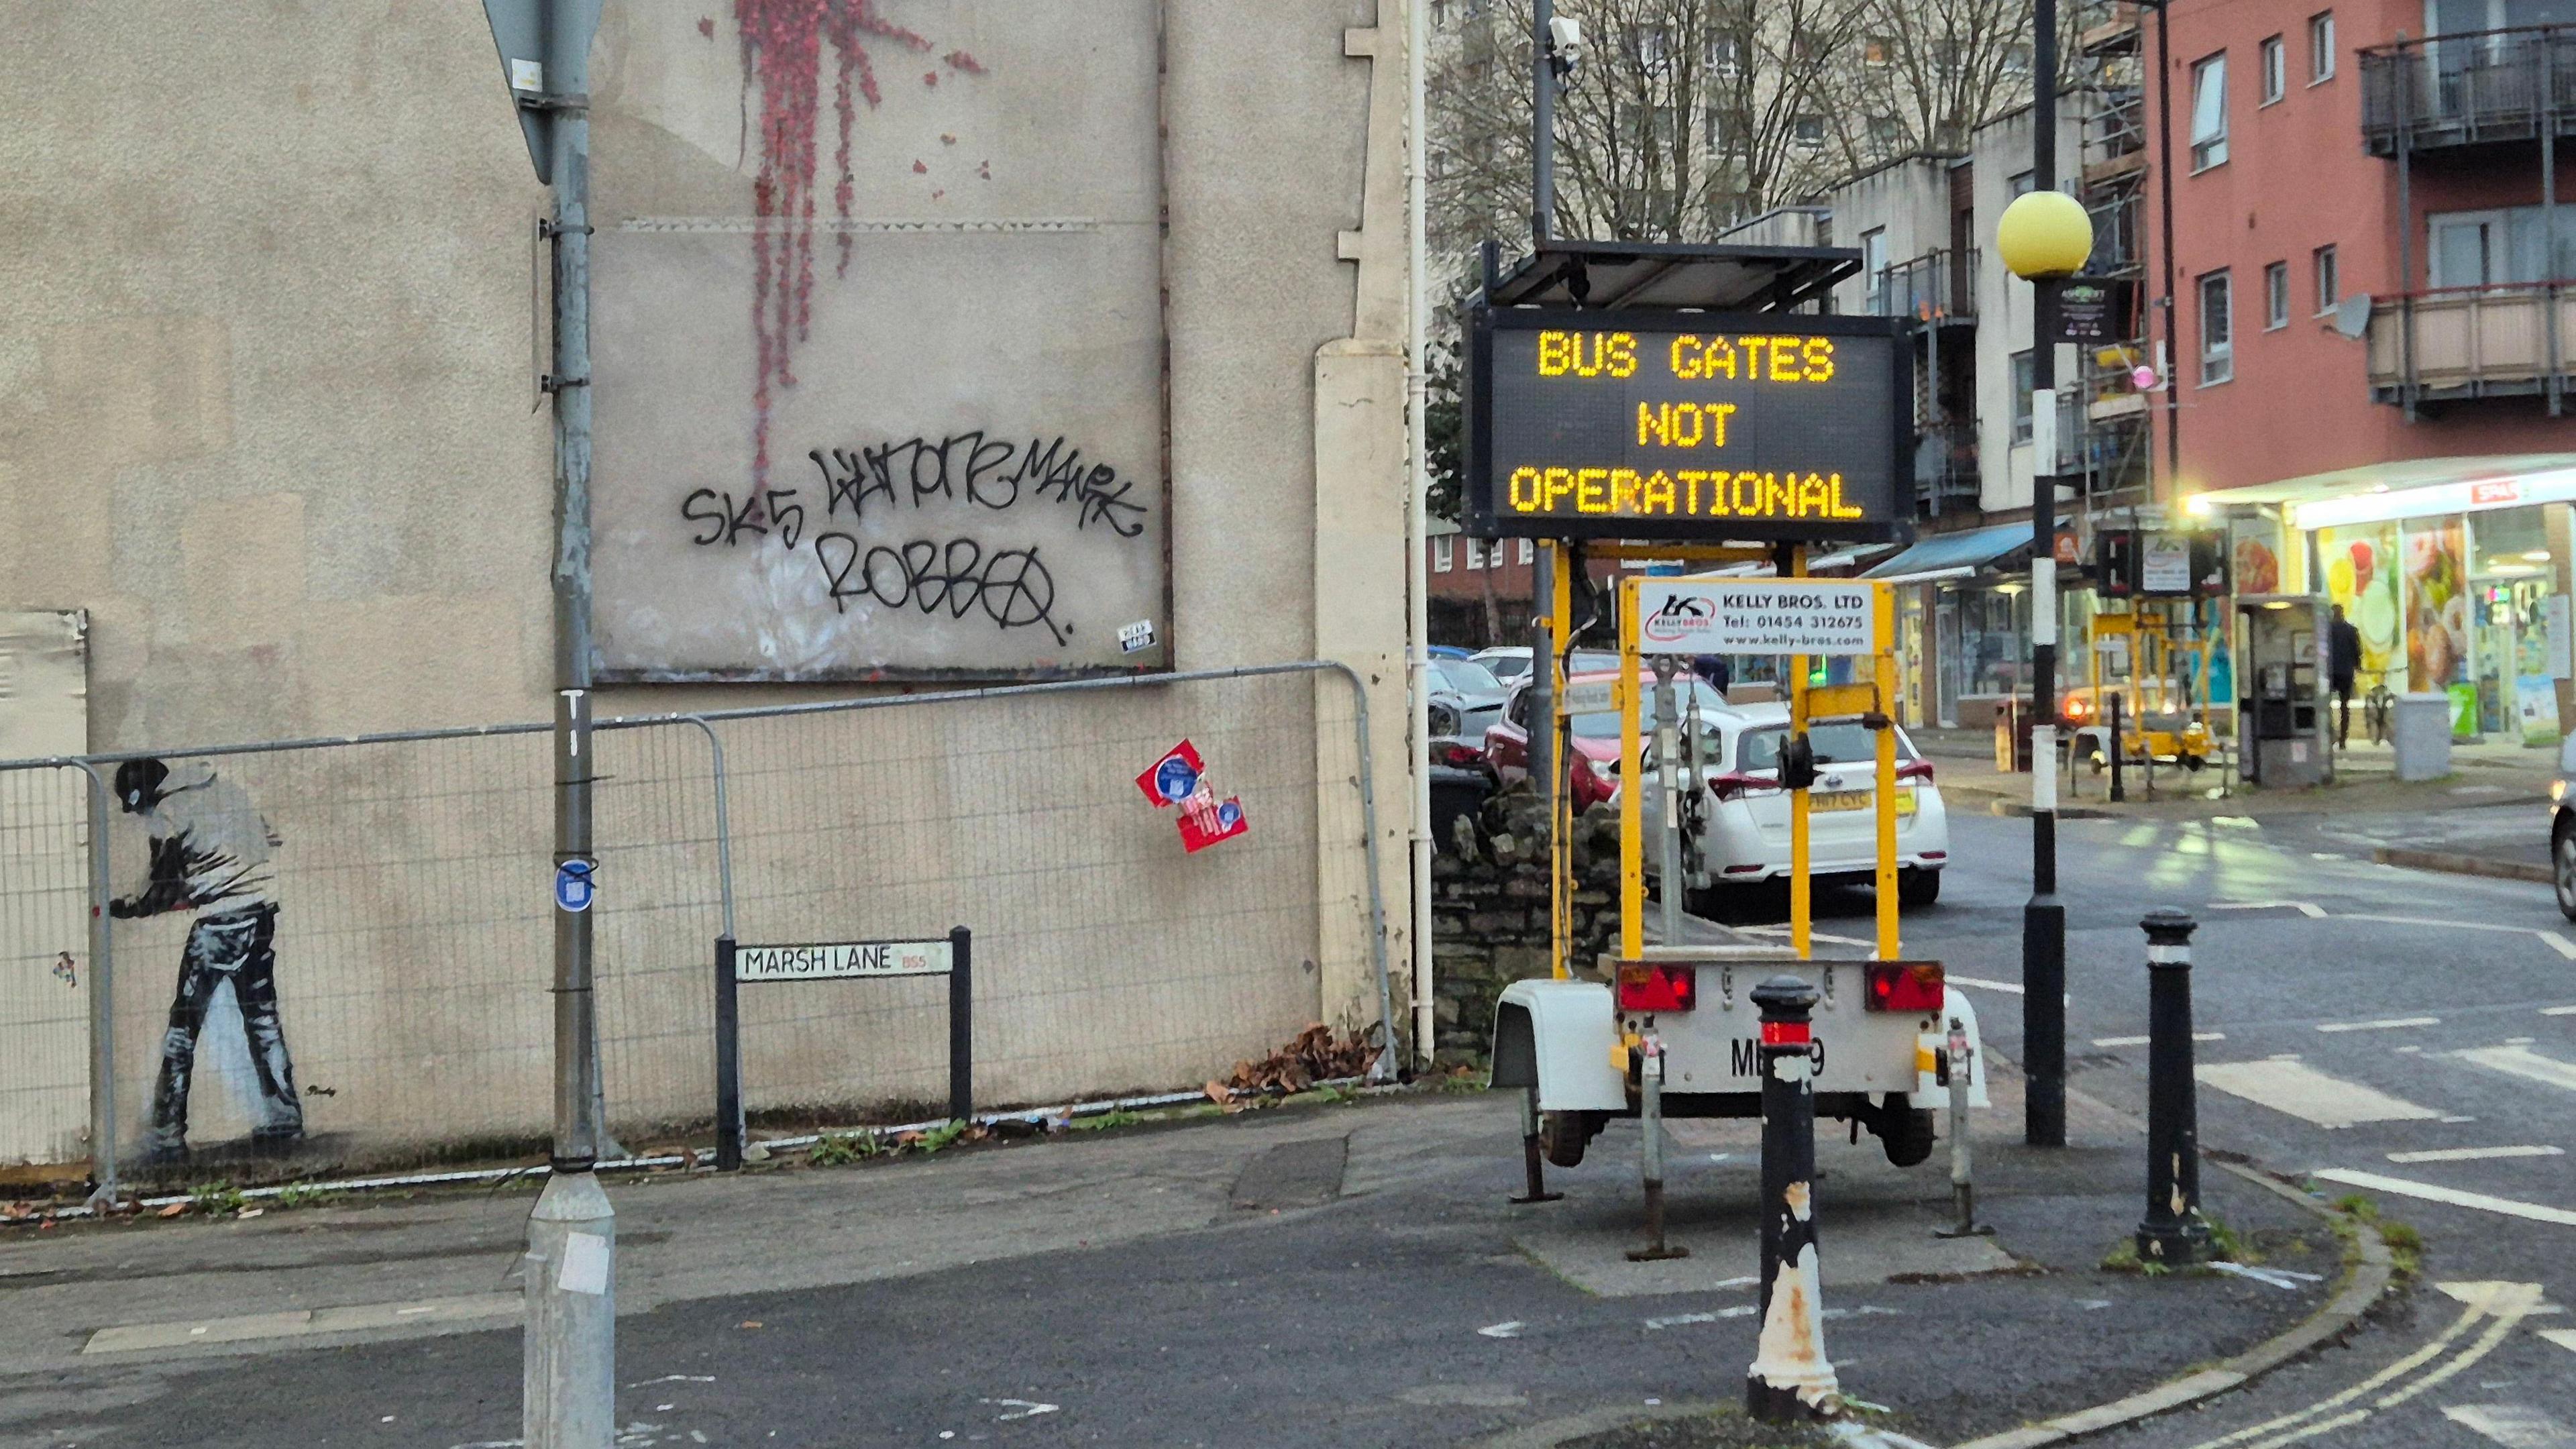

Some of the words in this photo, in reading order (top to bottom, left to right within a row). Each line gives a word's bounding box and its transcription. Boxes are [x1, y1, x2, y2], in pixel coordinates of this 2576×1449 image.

[1538, 331, 1637, 378] BUS
[1670, 335, 1835, 382] GATES
[1636, 400, 1737, 448] NOT
[1509, 466, 1863, 519] OPERATIONAL
[1723, 594, 1773, 609] KELLY
[1778, 594, 1827, 609] BROS.
[1834, 594, 1864, 609] LTD
[1723, 615, 1750, 629] Tel:
[1756, 615, 1803, 629] 01454
[1811, 614, 1864, 629] 312675
[1723, 633, 1864, 648] www.kelly-bros.com
[745, 948, 826, 975] MARSH
[834, 945, 892, 971] LANE
